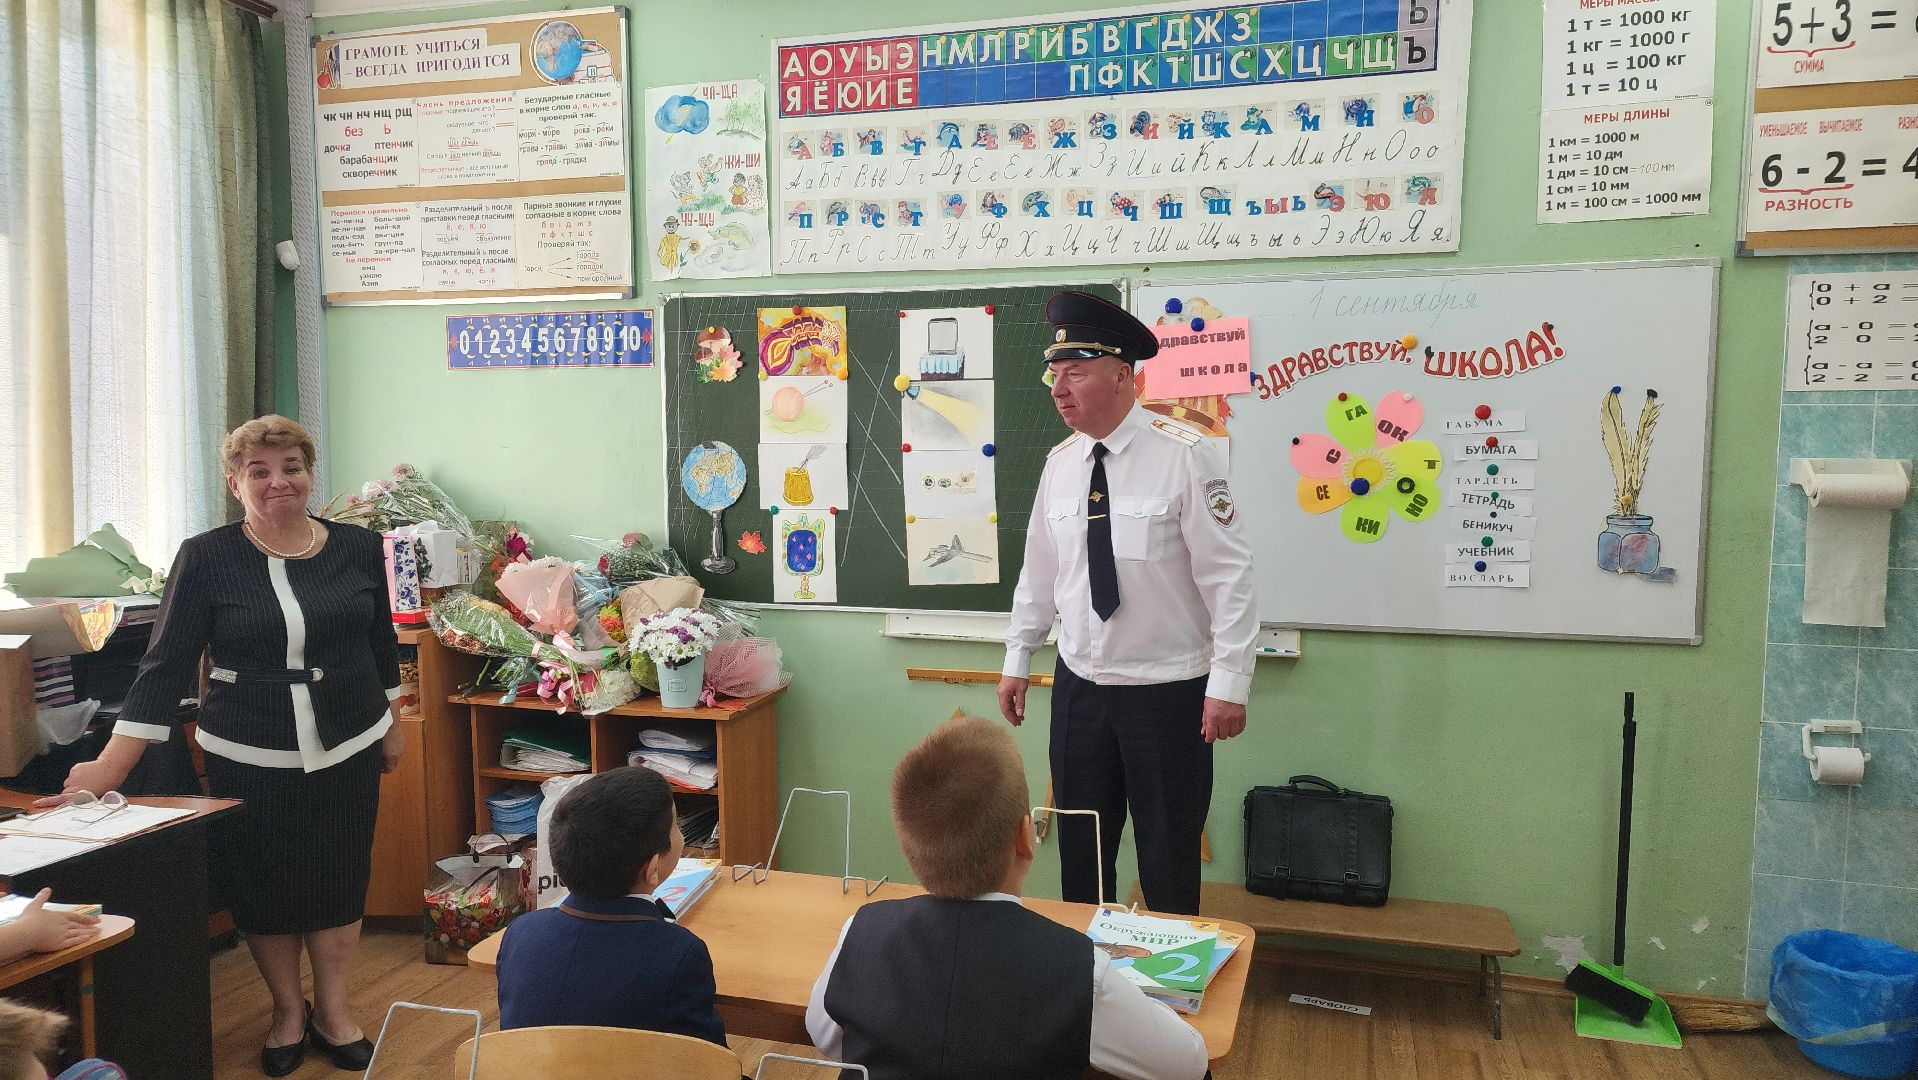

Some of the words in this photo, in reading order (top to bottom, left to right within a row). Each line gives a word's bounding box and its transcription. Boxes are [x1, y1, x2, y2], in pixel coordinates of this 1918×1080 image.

[1568, 19, 1577, 32] 1
[1583, 21, 1593, 30] т
[1600, 18, 1611, 27] =
[1620, 10, 1665, 27] 1000
[1671, 10, 1691, 22] кг
[345, 43, 409, 61] ГРАМОТЕ
[416, 38, 481, 56] УЧИТЬСЯ
[783, 52, 804, 78] А
[809, 49, 833, 72] О
[835, 46, 859, 74] У
[866, 45, 889, 72] Ы
[896, 43, 914, 69] Э
[922, 41, 942, 67] Н
[948, 38, 975, 64] М
[980, 35, 1001, 63] Л
[1014, 33, 1030, 59] Р
[1041, 27, 1063, 59] Й
[1071, 28, 1090, 55] Б
[1103, 23, 1120, 51] В
[1135, 21, 1152, 49] Г
[1161, 18, 1188, 51] Д
[1192, 17, 1223, 44] Ж
[1231, 12, 1251, 41] З
[1568, 40, 1577, 54] 1
[1583, 40, 1603, 52] кг
[1610, 39, 1621, 47] =
[1630, 31, 1674, 48] 1000
[1682, 32, 1690, 43] г
[355, 63, 407, 78] ВСЕГДА
[416, 53, 510, 75] ПРИГОДИТСЯ
[1567, 62, 1576, 75] 1
[1583, 63, 1594, 75] ц
[1607, 61, 1618, 69] =
[1626, 54, 1660, 70] 100
[1667, 54, 1686, 67] кг
[1794, 59, 1824, 73] СУММА
[1567, 83, 1575, 96] 1
[1582, 85, 1591, 95] т
[1599, 83, 1610, 92] =
[1618, 77, 1639, 92] 10
[1647, 79, 1657, 91] ц
[449, 96, 512, 107] предложения
[525, 94, 573, 104] Безударные
[576, 91, 611, 99] гласные
[324, 112, 336, 122] чк
[340, 111, 352, 120] чн
[356, 110, 370, 120] нч
[374, 109, 391, 119] нщ
[395, 108, 412, 119] рщ
[526, 105, 549, 114] корне
[1584, 112, 1619, 124] МЕРЫ
[1624, 108, 1670, 122] ДЛИНЫ
[539, 113, 577, 122] проверяй
[345, 126, 363, 137] без
[324, 143, 350, 153] дочка
[375, 139, 413, 150] птенчик
[1548, 138, 1555, 148] 1
[1560, 138, 1577, 147] км
[1581, 136, 1590, 144] =
[1594, 132, 1626, 144] 1000
[1630, 133, 1640, 142] м
[340, 154, 398, 166] барабанщик
[342, 168, 397, 179] скворечник
[1761, 153, 1783, 187] 6
[1824, 151, 1847, 184] 2
[1862, 158, 1887, 176] =
[425, 204, 482, 214] Разделительный
[524, 202, 552, 210] Парные
[596, 199, 621, 208] глухие
[1765, 197, 1853, 211] РАЗНОСТЬ
[526, 212, 564, 220] согласные
[573, 210, 596, 218] корне
[537, 240, 575, 248] Проверяй
[422, 248, 480, 259] Разделительный
[1310, 285, 1325, 319] 1
[1336, 280, 1478, 328] сентября
[460, 330, 470, 354] 0
[475, 330, 483, 353] 1
[490, 329, 500, 353] 2
[506, 329, 516, 353] 3
[521, 328, 531, 352] 4
[537, 328, 548, 352] 5
[554, 328, 565, 352] 6
[571, 327, 581, 352] 7
[587, 327, 597, 352] 8
[603, 327, 613, 351] 9
[619, 326, 641, 351] 10
[1424, 322, 1564, 378] ШКОЛА!
[1345, 404, 1368, 421] ГА
[1377, 419, 1410, 442] ОК
[1446, 420, 1503, 429] ГАБУМА
[1465, 445, 1517, 454] БУМАГА
[1455, 477, 1518, 485] ТАРДЕТЬ
[1315, 484, 1331, 501] СЕ
[1462, 493, 1515, 510] ТЕТРАДЬ
[1355, 516, 1381, 535] КИ
[1462, 519, 1513, 532] БЕНИКУЧ
[1457, 546, 1514, 557] УЧЕБНИК
[1450, 574, 1514, 582] ВОСЛАРЬ
[1154, 953, 1201, 983] 2
